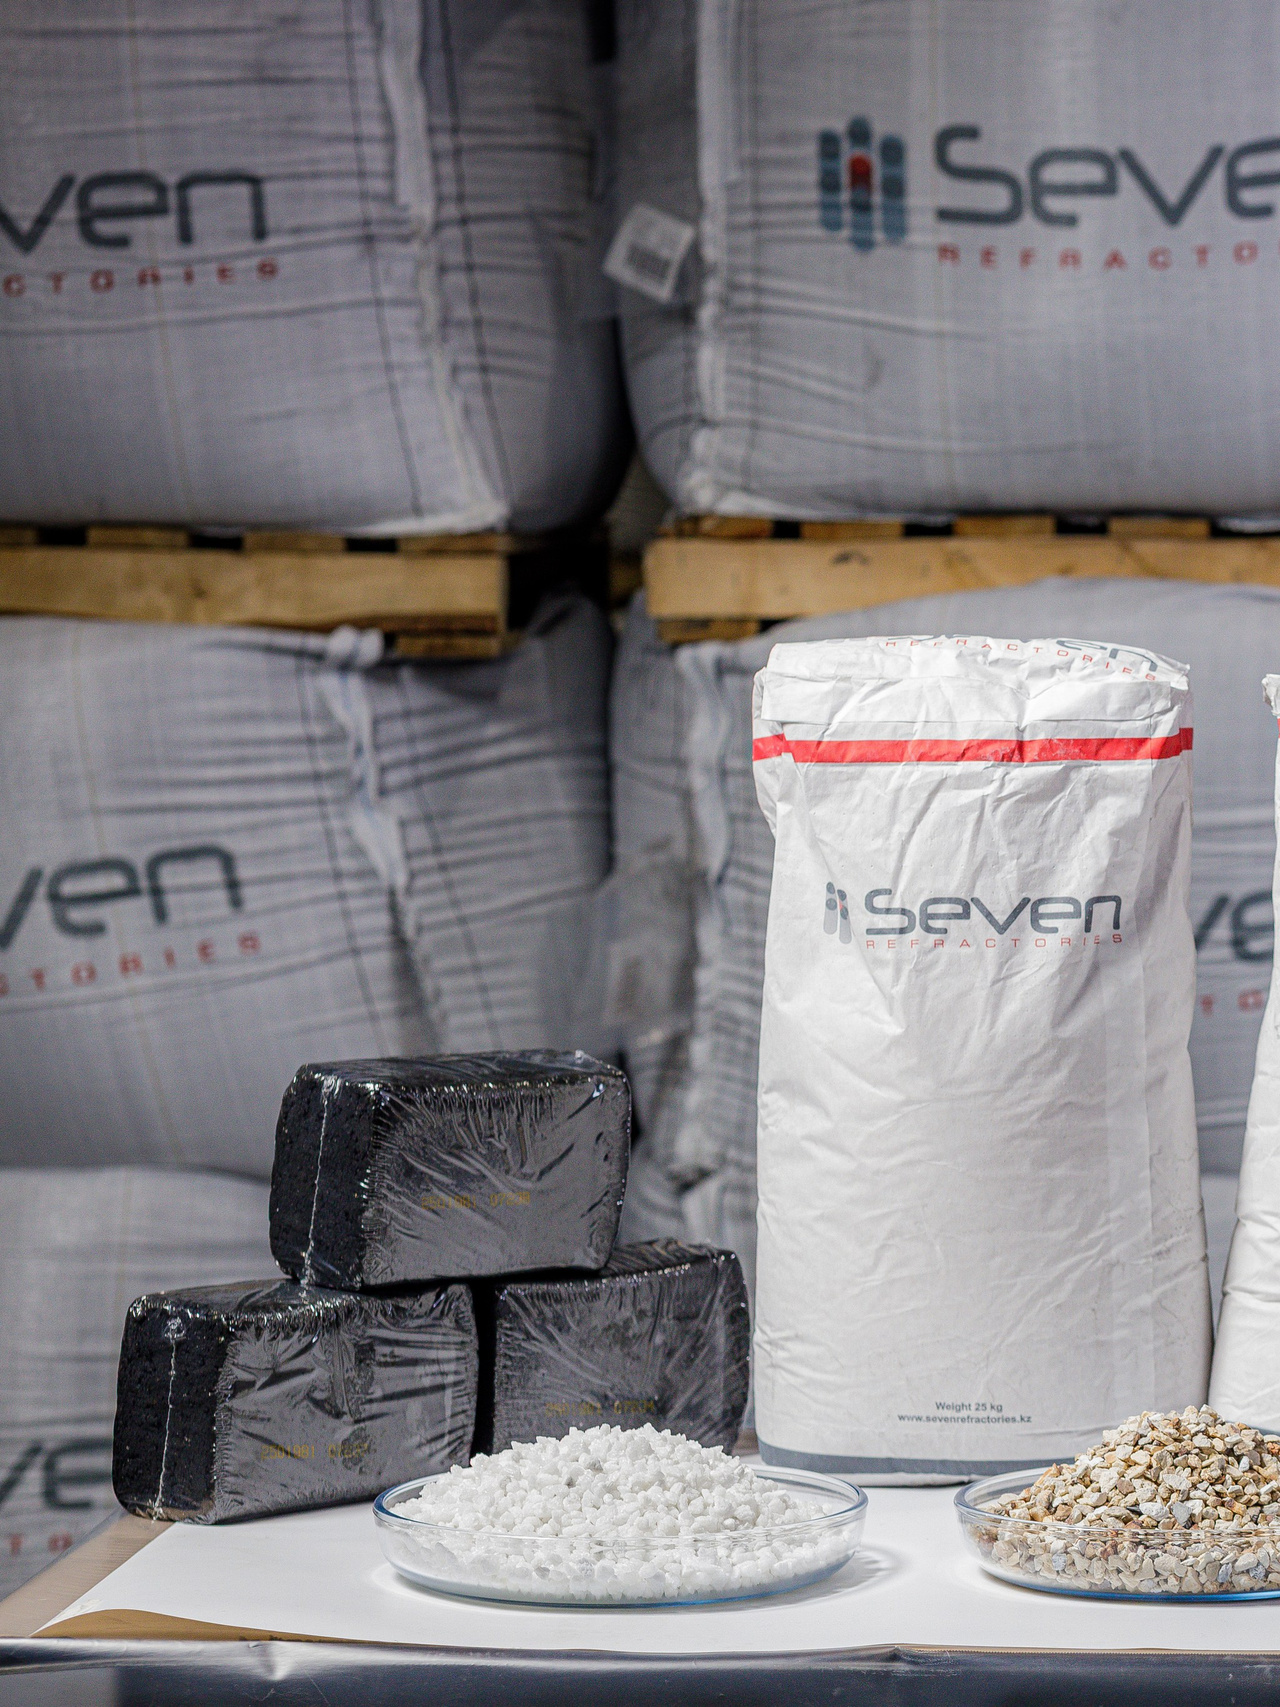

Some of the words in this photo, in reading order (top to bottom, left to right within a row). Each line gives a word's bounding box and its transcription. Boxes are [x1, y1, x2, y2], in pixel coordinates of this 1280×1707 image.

[866, 888, 1122, 936] Seven
[865, 933, 1123, 950] REFRACTORIES
[935, 1402, 972, 1413] Weight
[975, 1402, 987, 1411] 25
[990, 1402, 1003, 1413] kg
